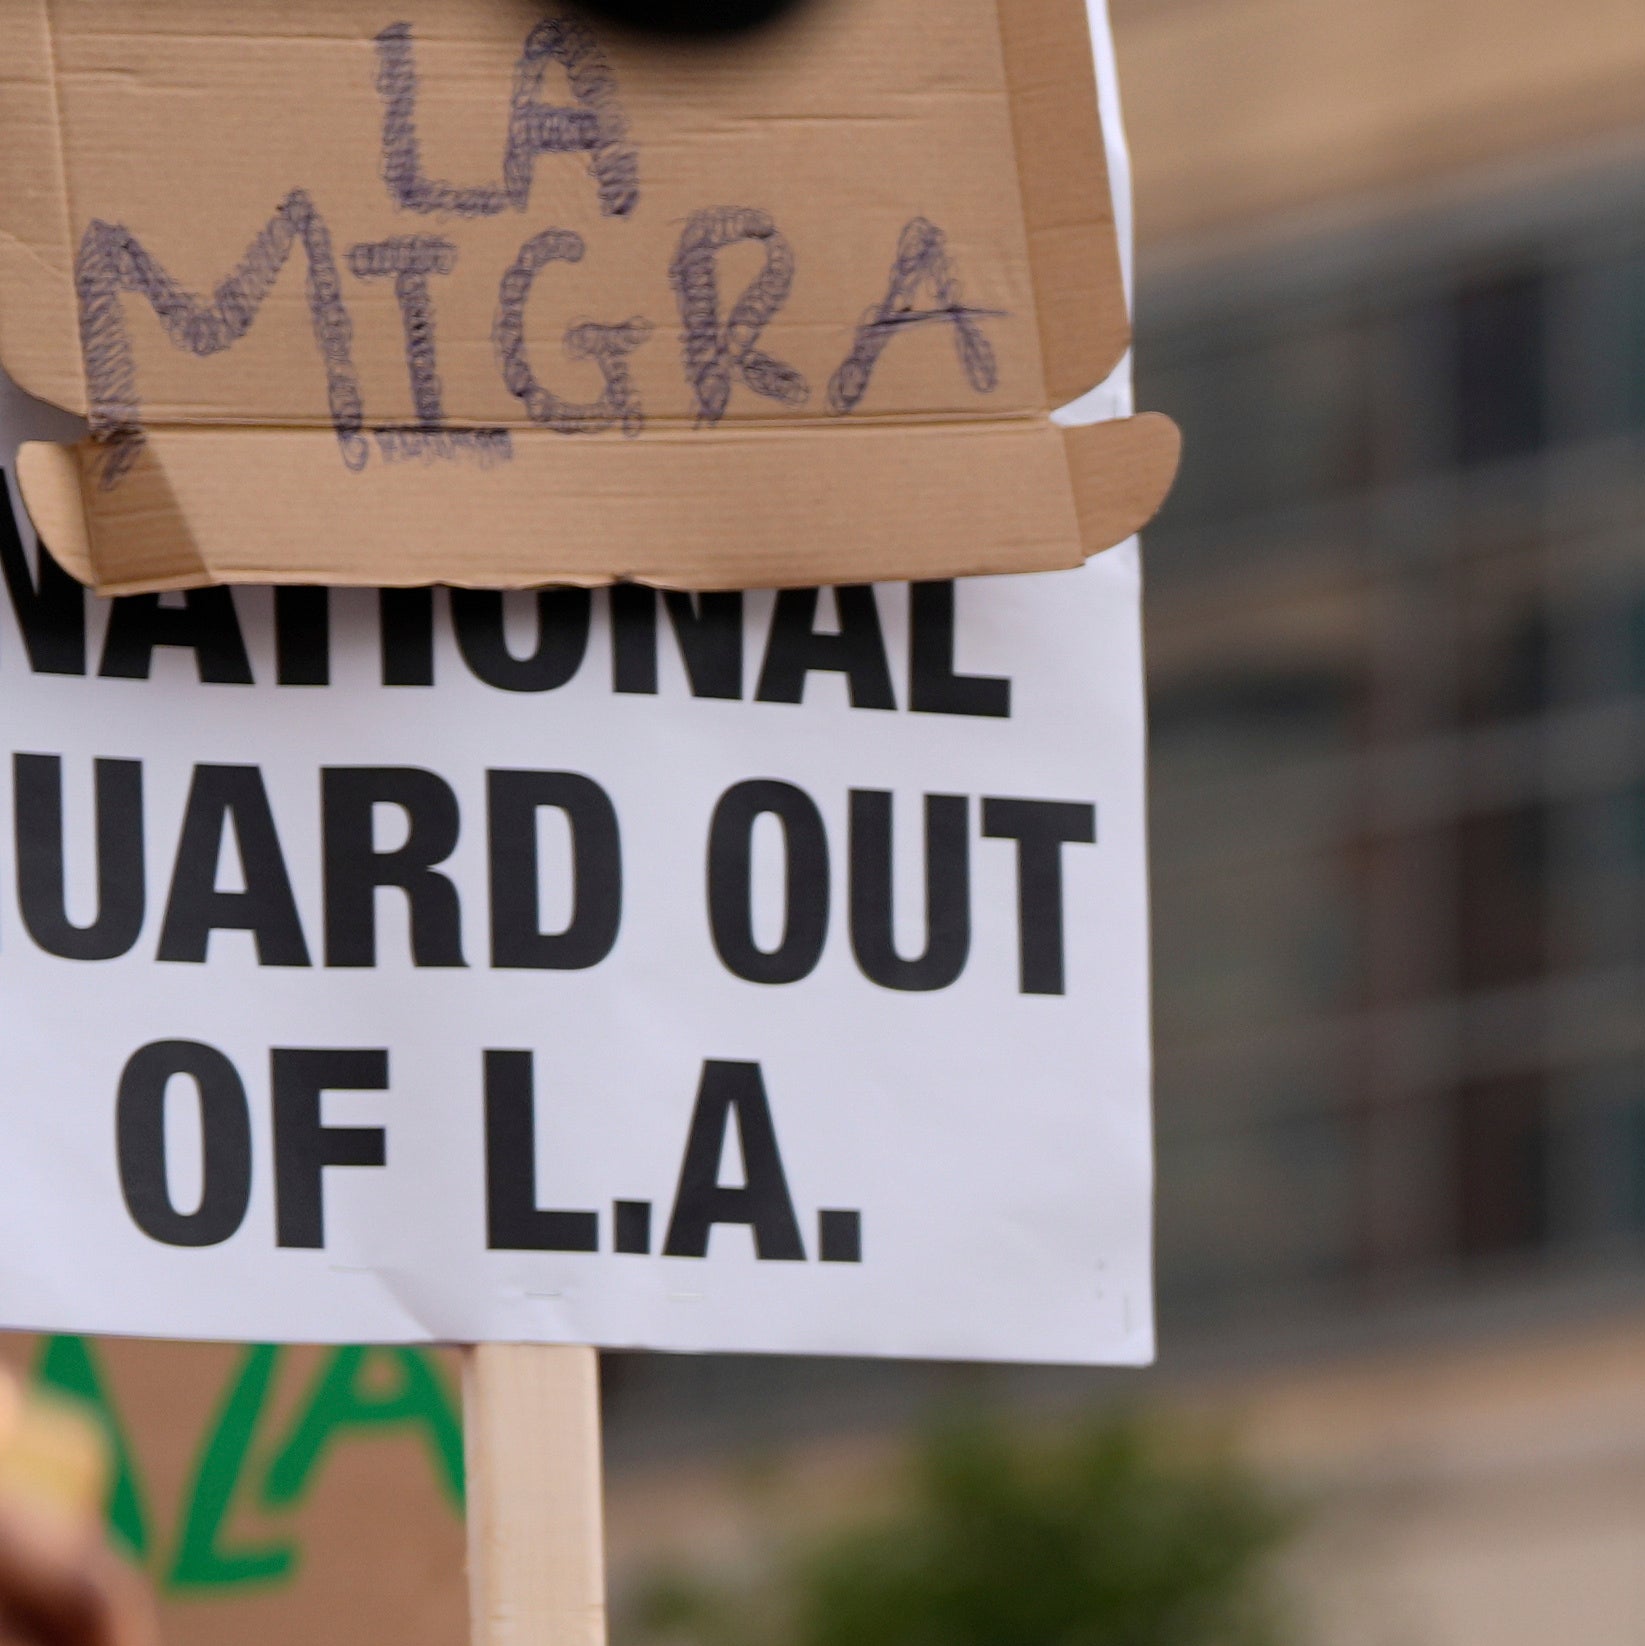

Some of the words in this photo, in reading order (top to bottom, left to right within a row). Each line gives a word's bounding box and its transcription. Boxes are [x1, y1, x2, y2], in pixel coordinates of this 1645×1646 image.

[375, 17, 641, 218] LA
[76, 188, 1008, 489] MIGRA
[706, 779, 1096, 996] OUT
[116, 1039, 390, 1249] OF
[482, 1049, 861, 1263] L.A.
